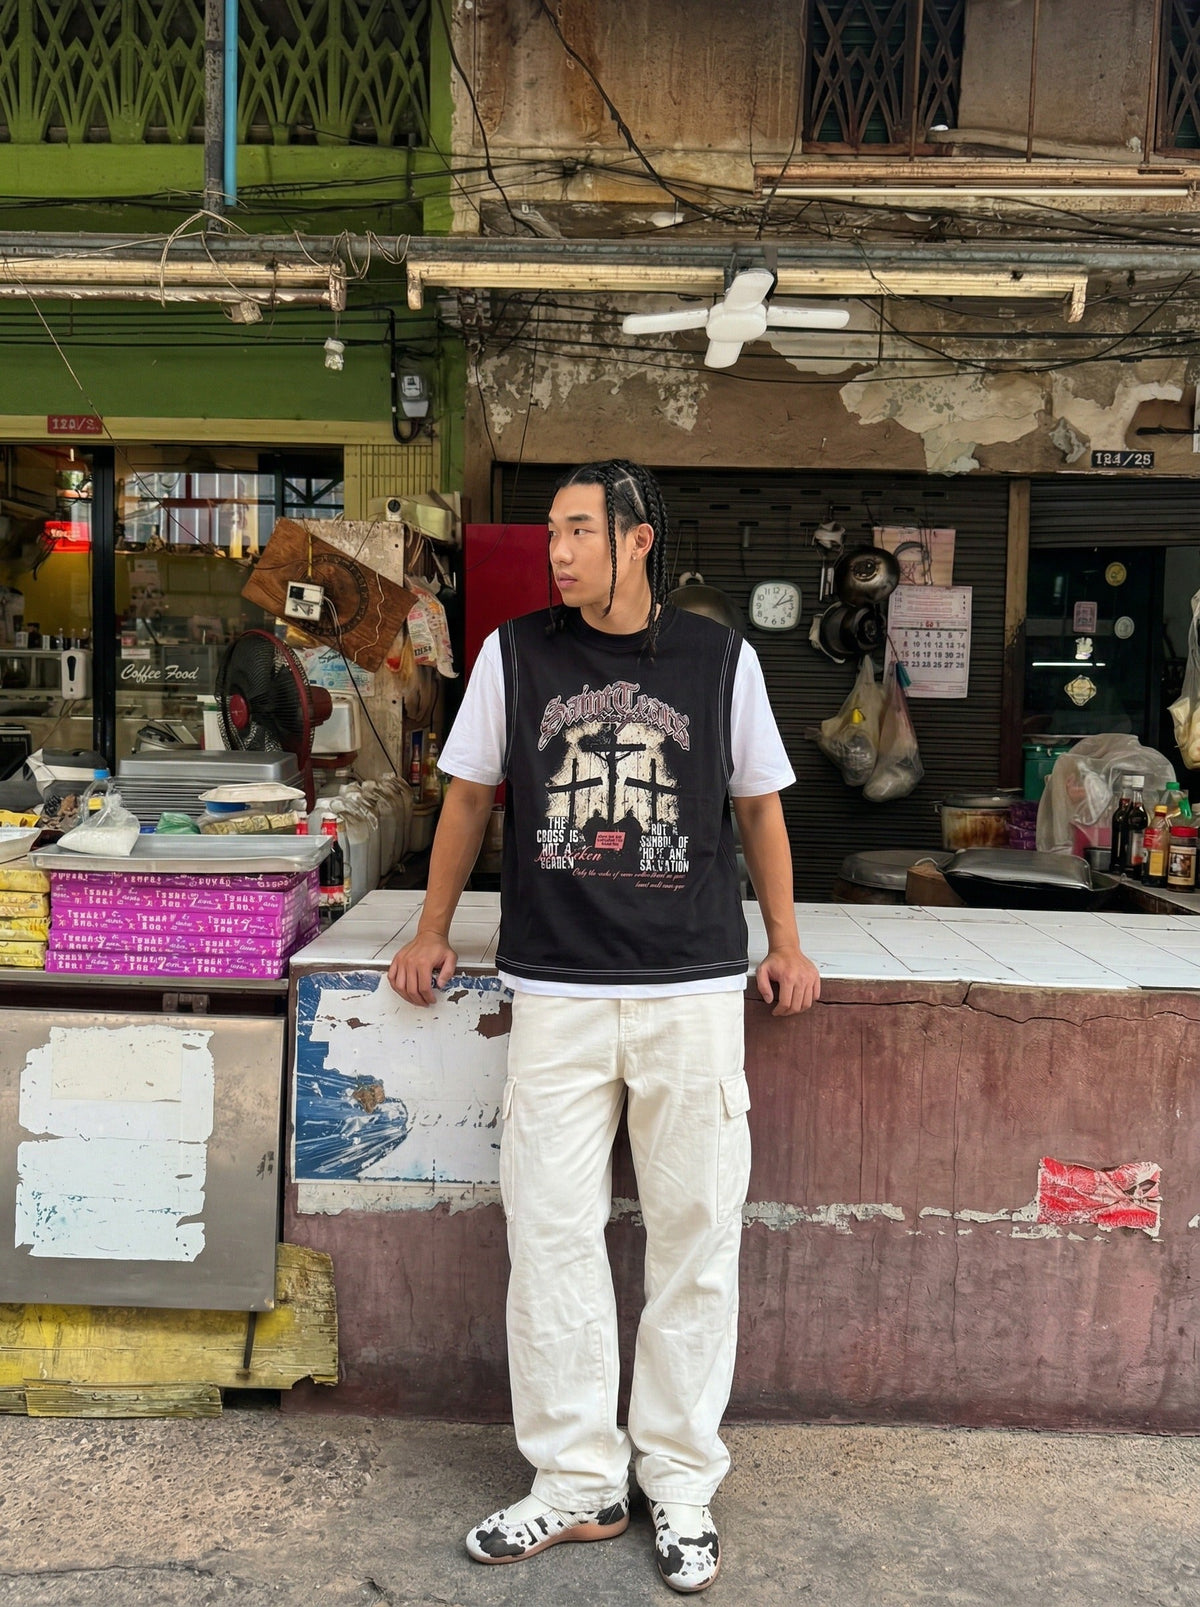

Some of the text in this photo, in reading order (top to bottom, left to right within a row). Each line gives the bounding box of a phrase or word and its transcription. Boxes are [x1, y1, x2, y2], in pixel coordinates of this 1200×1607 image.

[121, 663, 200, 683] Coffee Food
[548, 816, 566, 830] THE
[569, 829, 579, 843] IS
[678, 836, 689, 849] OF
